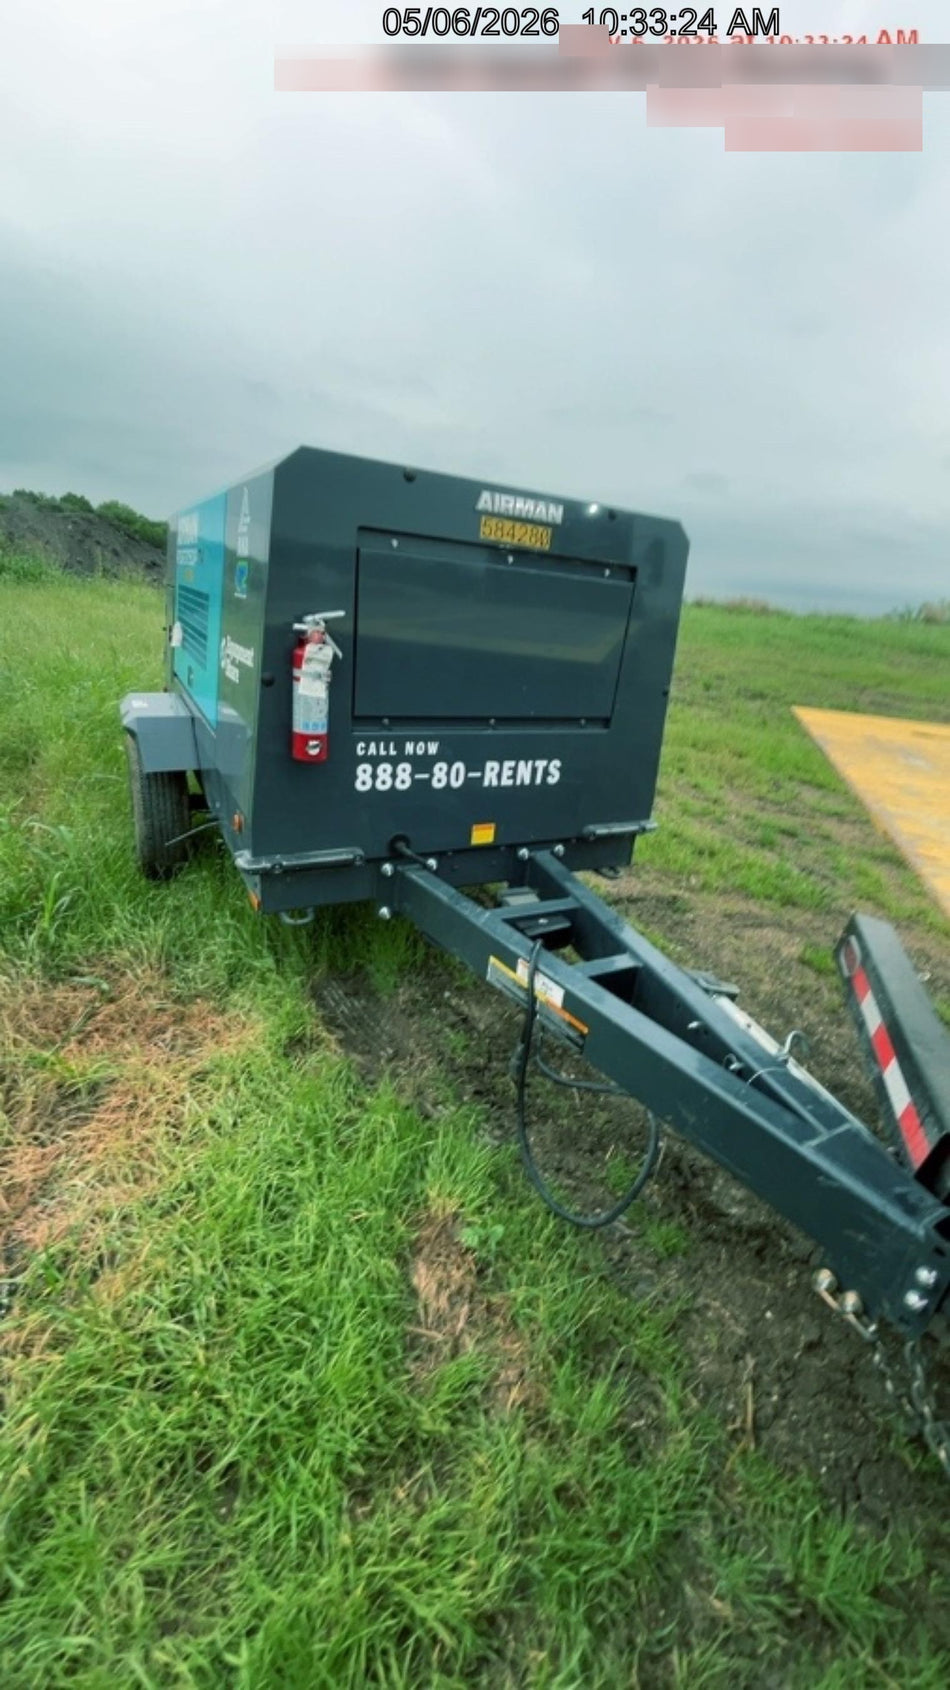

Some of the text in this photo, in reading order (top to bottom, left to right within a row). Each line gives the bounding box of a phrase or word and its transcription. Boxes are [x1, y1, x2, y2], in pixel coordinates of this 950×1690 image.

[475, 490, 564, 525] AIRMAN
[356, 741, 440, 756] CALL NOW
[354, 758, 562, 792] 888-80-RENTS
